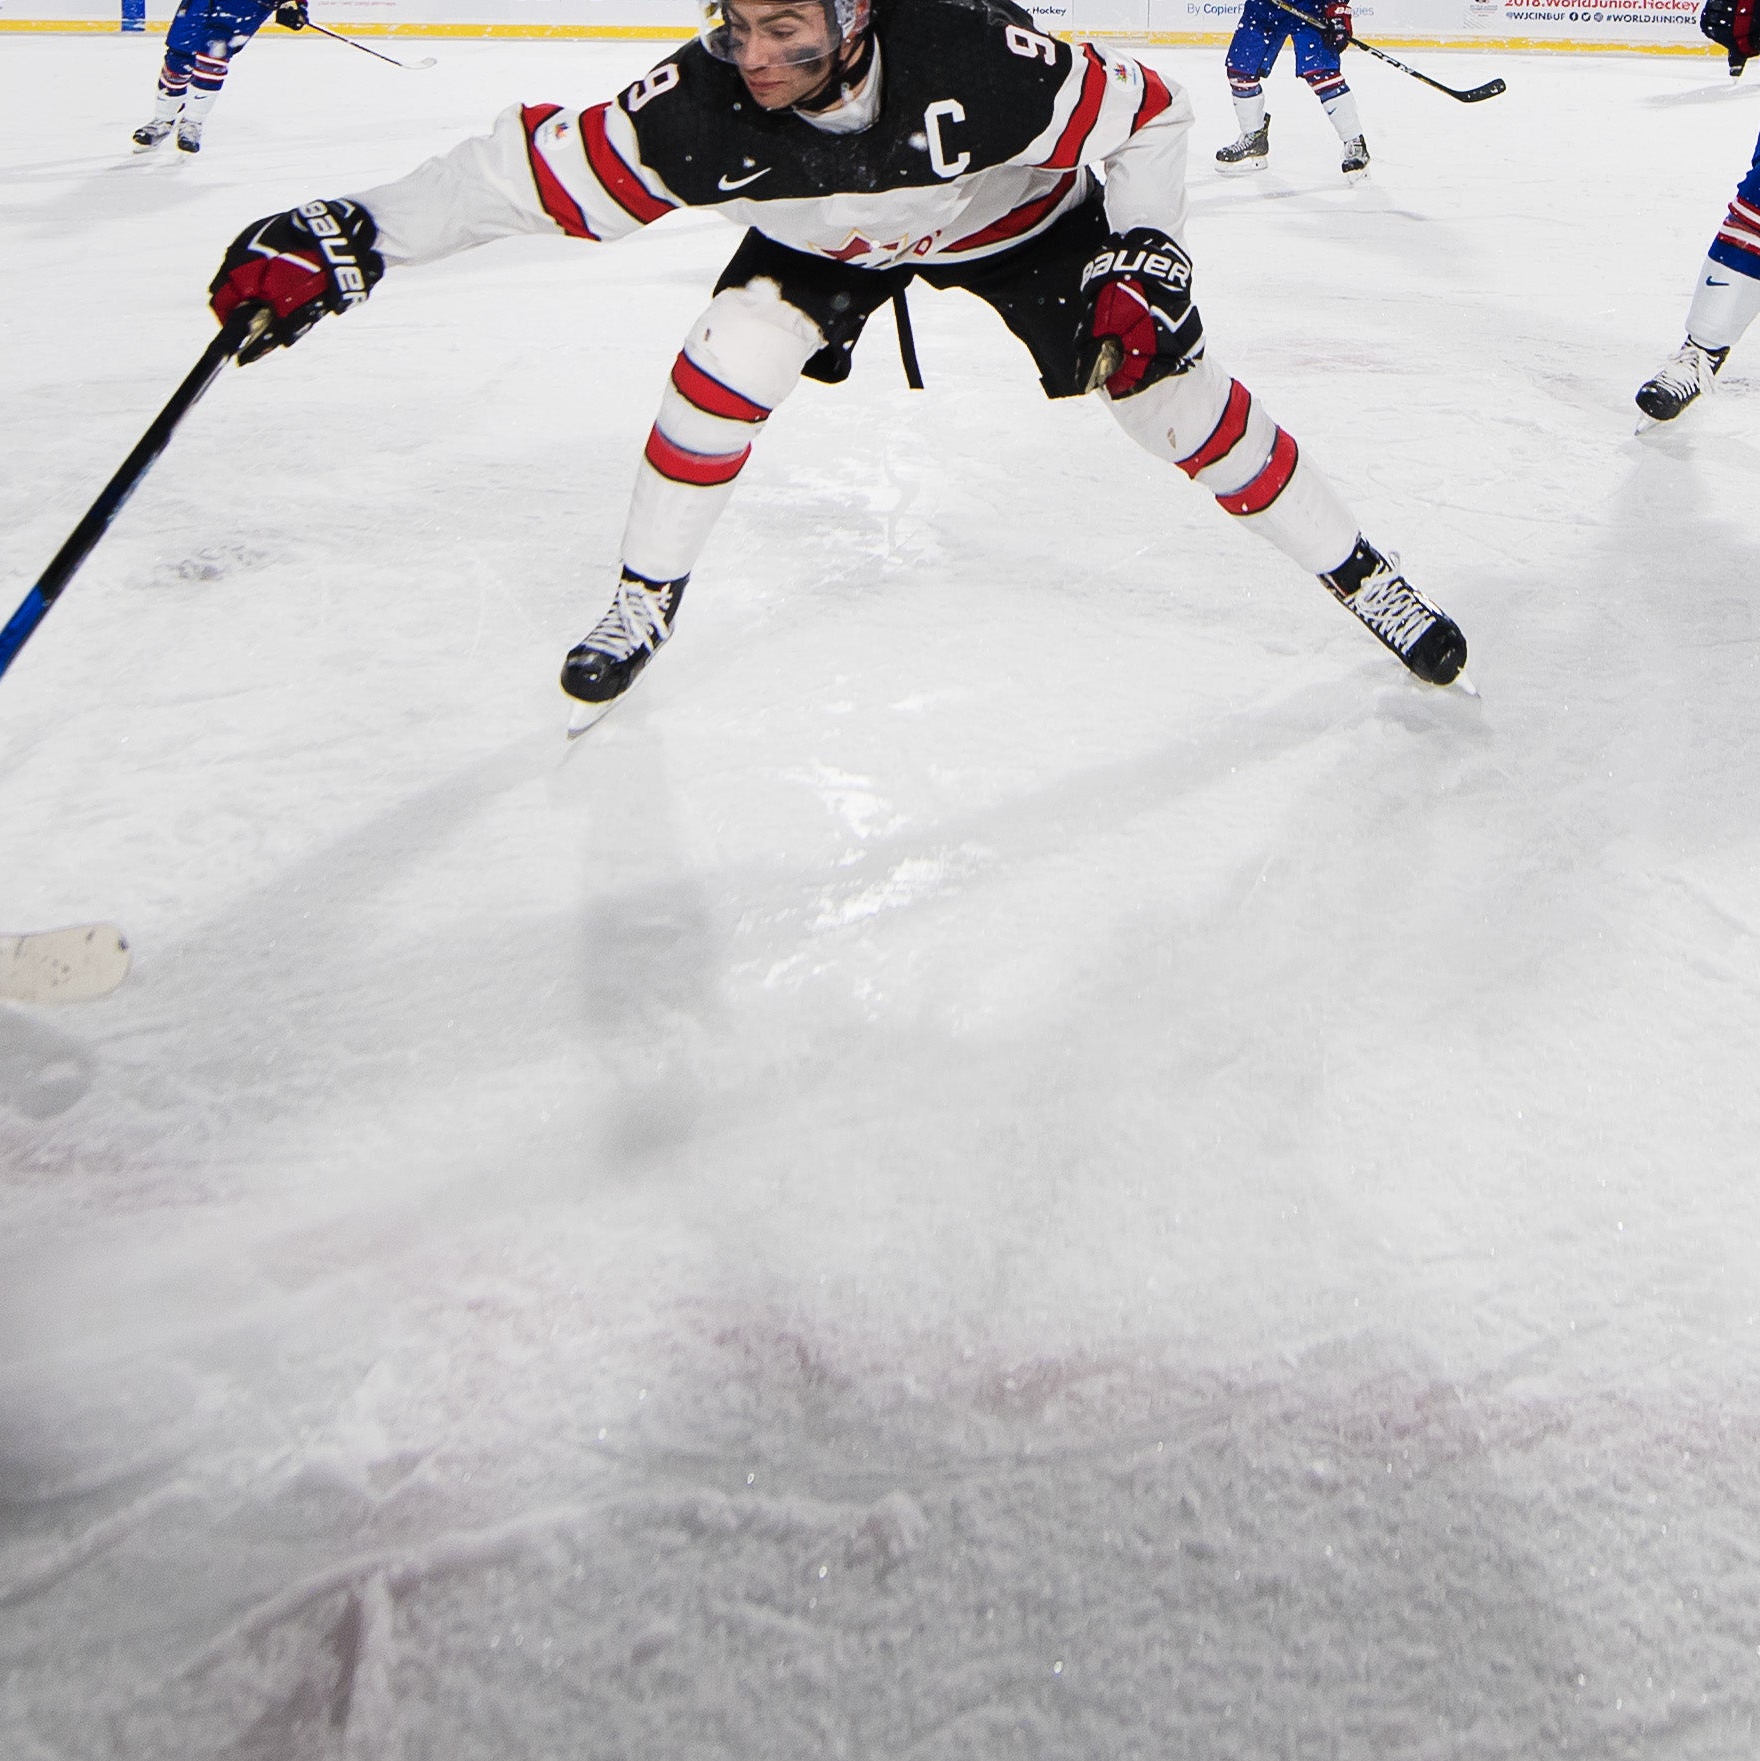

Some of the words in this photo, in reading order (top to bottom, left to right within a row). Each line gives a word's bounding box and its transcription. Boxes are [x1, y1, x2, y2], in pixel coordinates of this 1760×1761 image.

[1187, 2, 1202, 15] By
[1203, 2, 1243, 15] CopierF
[1605, 13, 1698, 26] #WORLDJUNIORS
[1004, 23, 1057, 67] 9
[626, 62, 680, 113] 9
[924, 98, 973, 179] C
[292, 200, 369, 310] BAUER
[1080, 248, 1191, 292] BAUER
